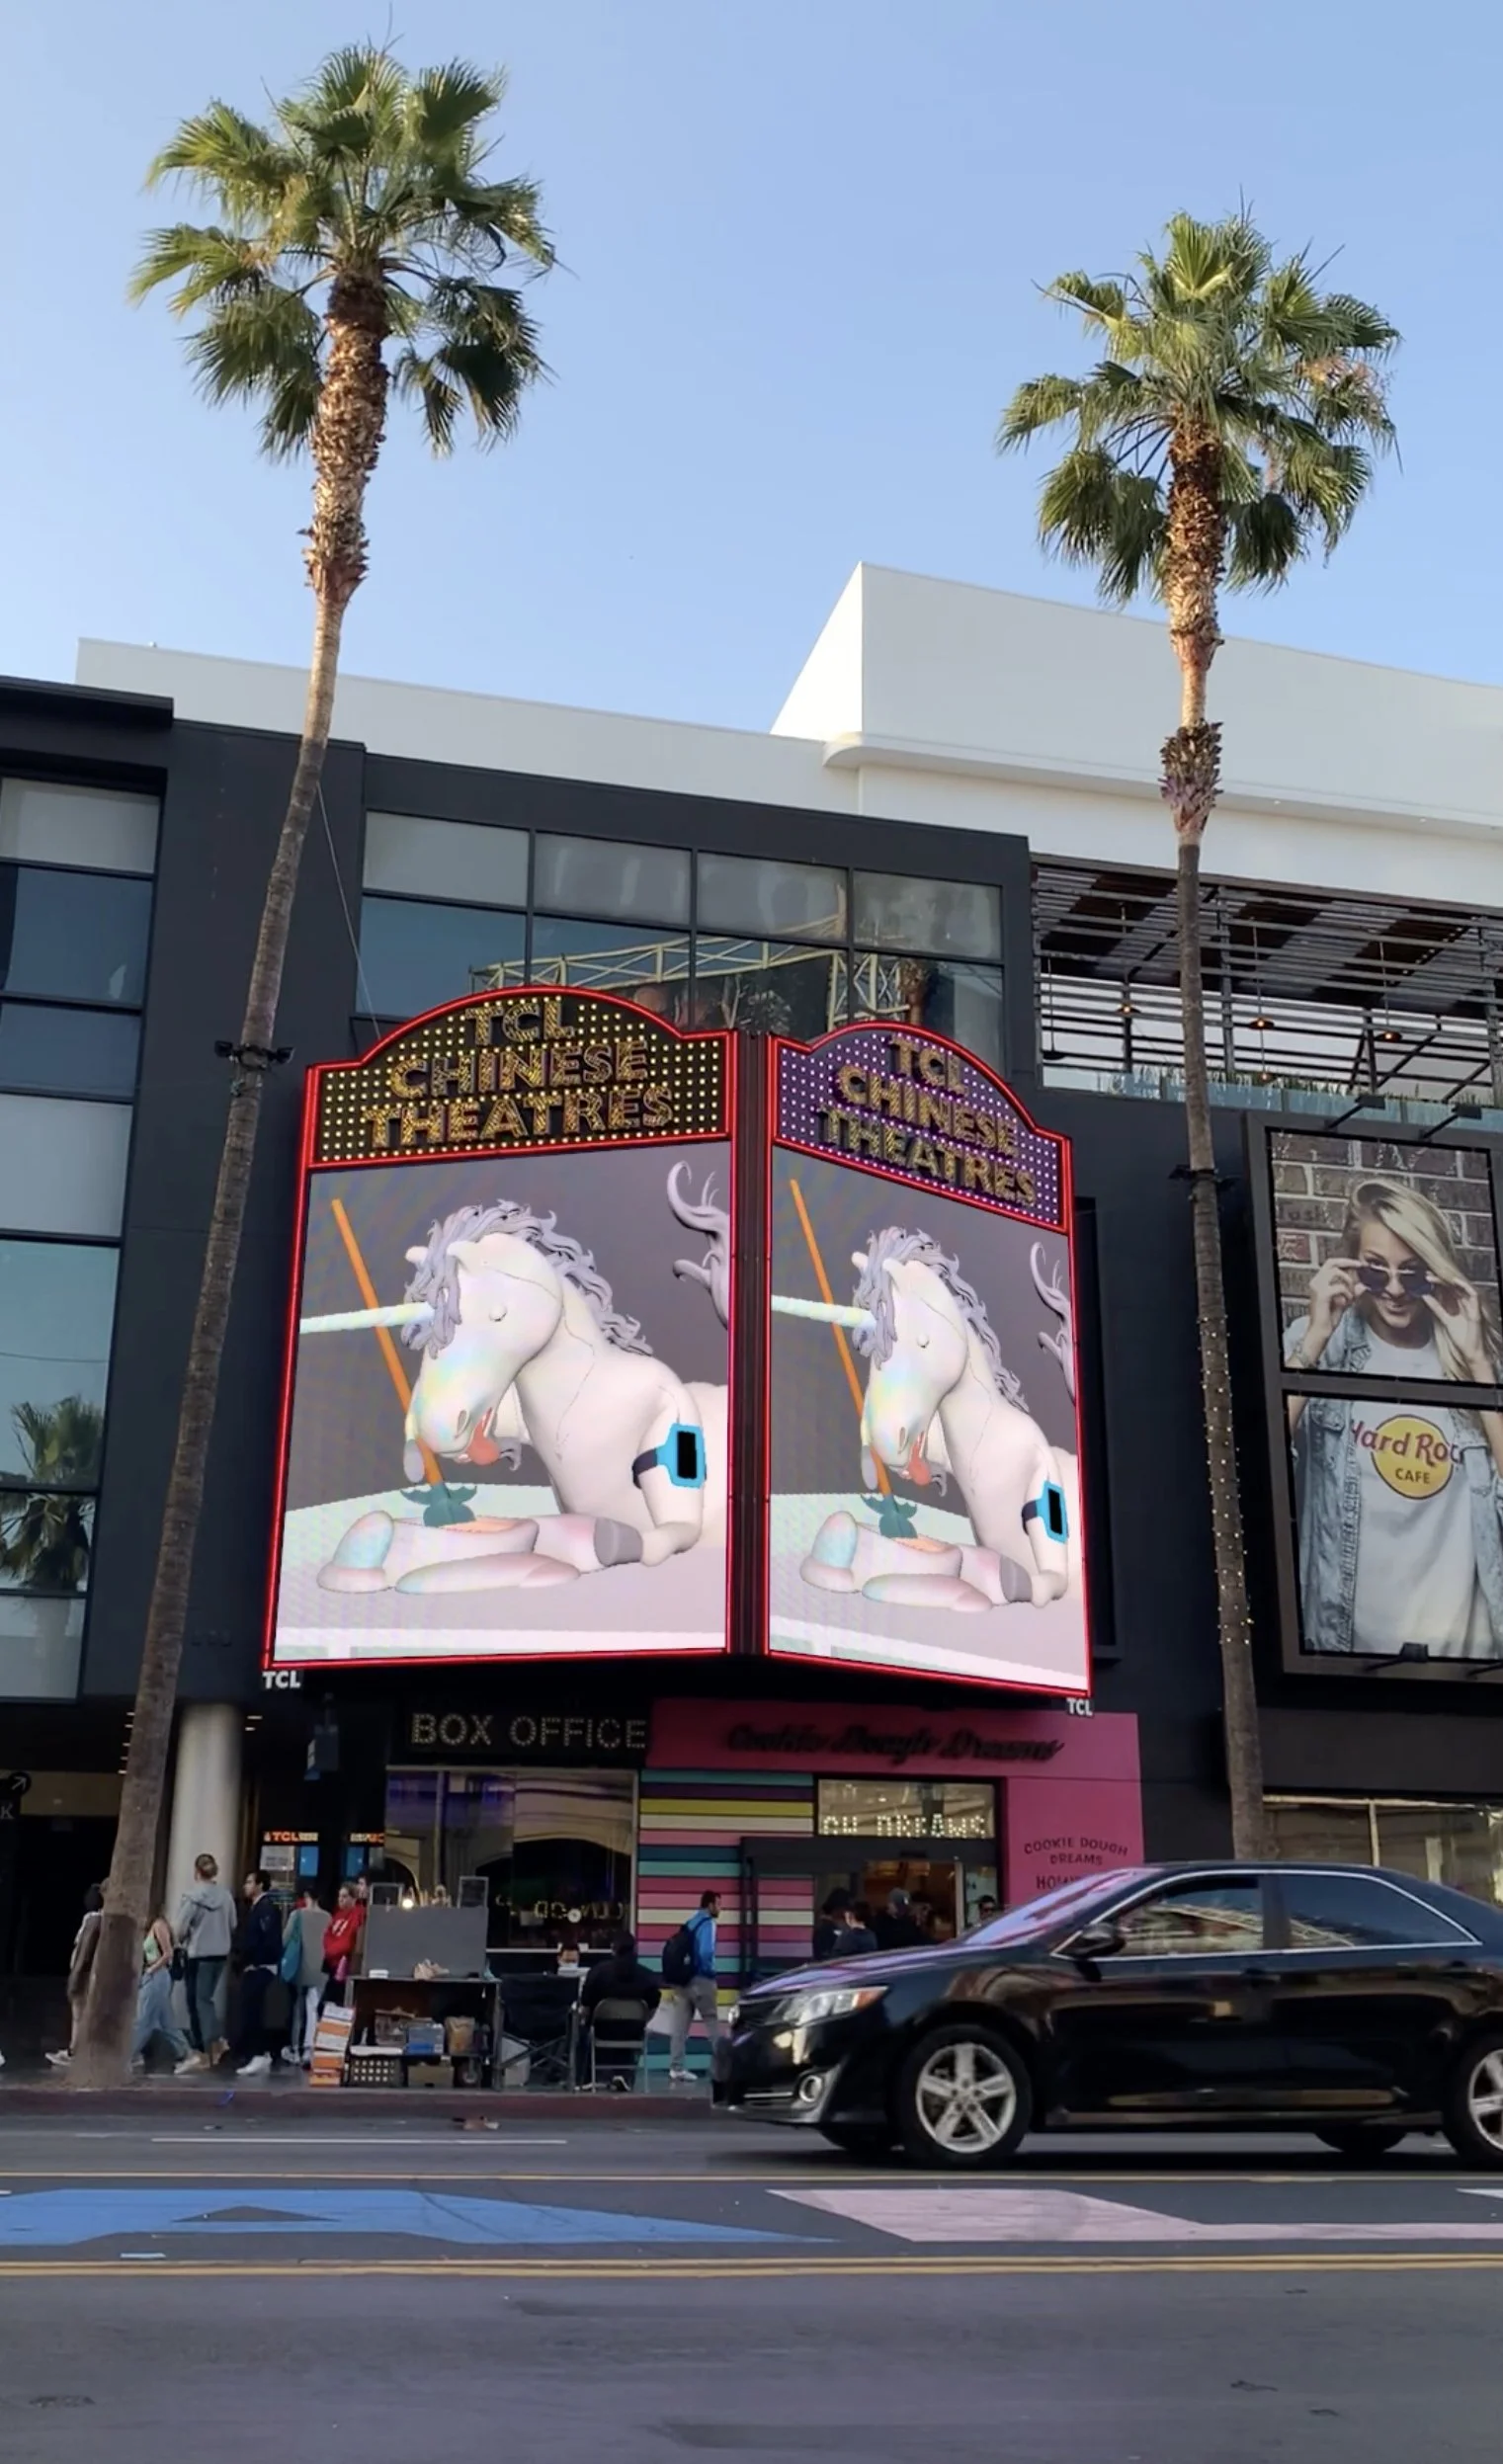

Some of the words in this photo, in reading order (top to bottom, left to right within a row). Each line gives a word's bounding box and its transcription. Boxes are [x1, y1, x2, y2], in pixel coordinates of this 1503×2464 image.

[465, 997, 576, 1046] TCL
[390, 1040, 649, 1099] CHINESE
[889, 1034, 969, 1094] TCL
[362, 1086, 674, 1149] THEATRES
[836, 1064, 1019, 1156] CHINESE
[817, 1104, 1036, 1207] THEATRES
[1415, 1432, 1463, 1468] Roc
[1394, 1467, 1431, 1484] CAFE
[263, 1670, 301, 1689] TCL
[1067, 1697, 1094, 1717] TCL
[411, 1712, 493, 1747] BOX
[510, 1715, 648, 1750] OFFICE
[1024, 1837, 1074, 1854] COOKIE
[1080, 1837, 1128, 1856] DOUGH
[1049, 1852, 1104, 1866] DREAMS
